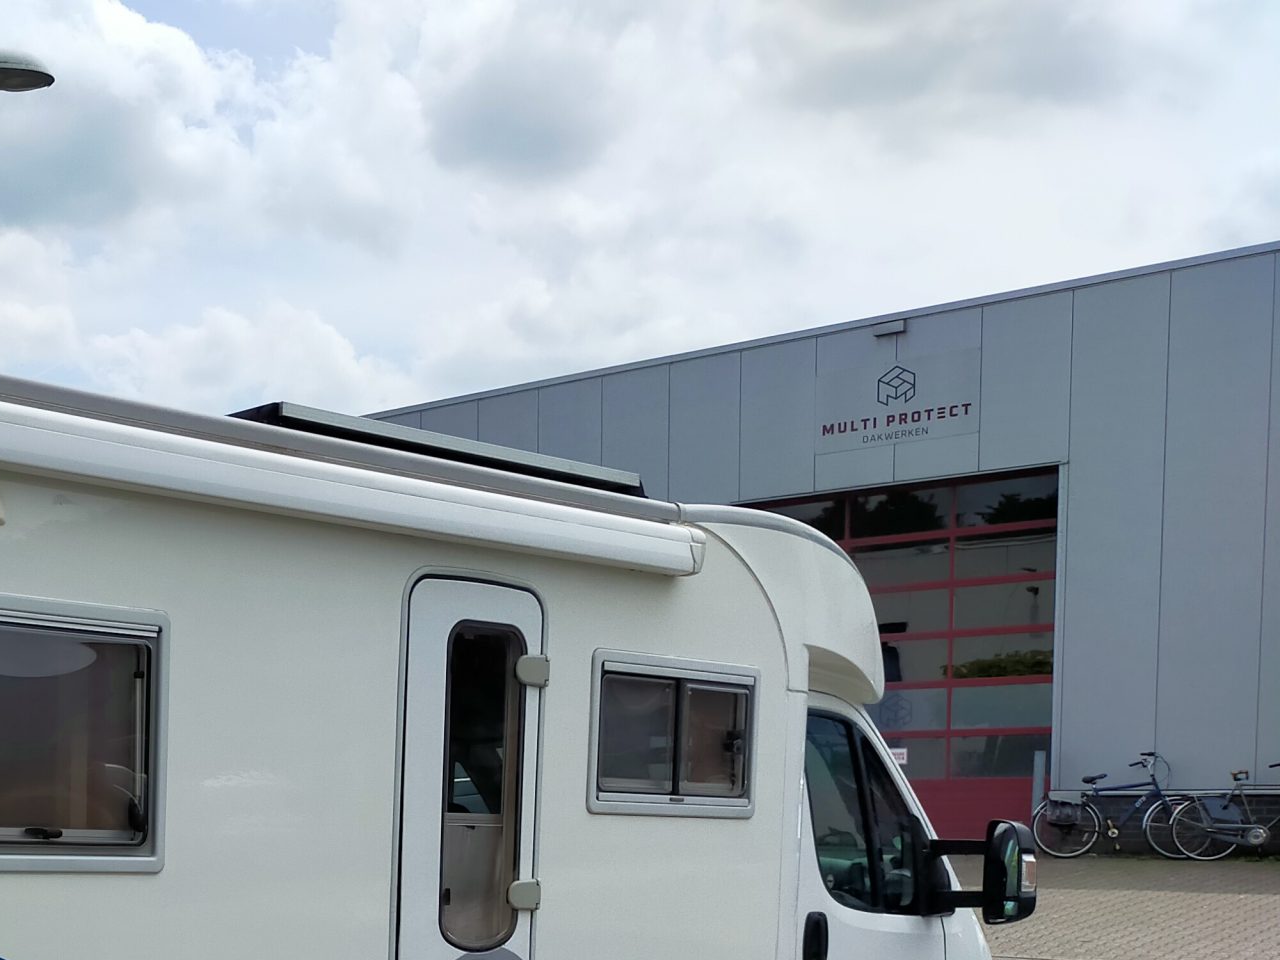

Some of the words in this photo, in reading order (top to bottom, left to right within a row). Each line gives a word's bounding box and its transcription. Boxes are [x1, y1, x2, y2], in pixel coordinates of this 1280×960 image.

[822, 416, 878, 436] MULTI
[886, 403, 972, 427] PROTECT
[862, 426, 929, 444] DAKWERKEN
